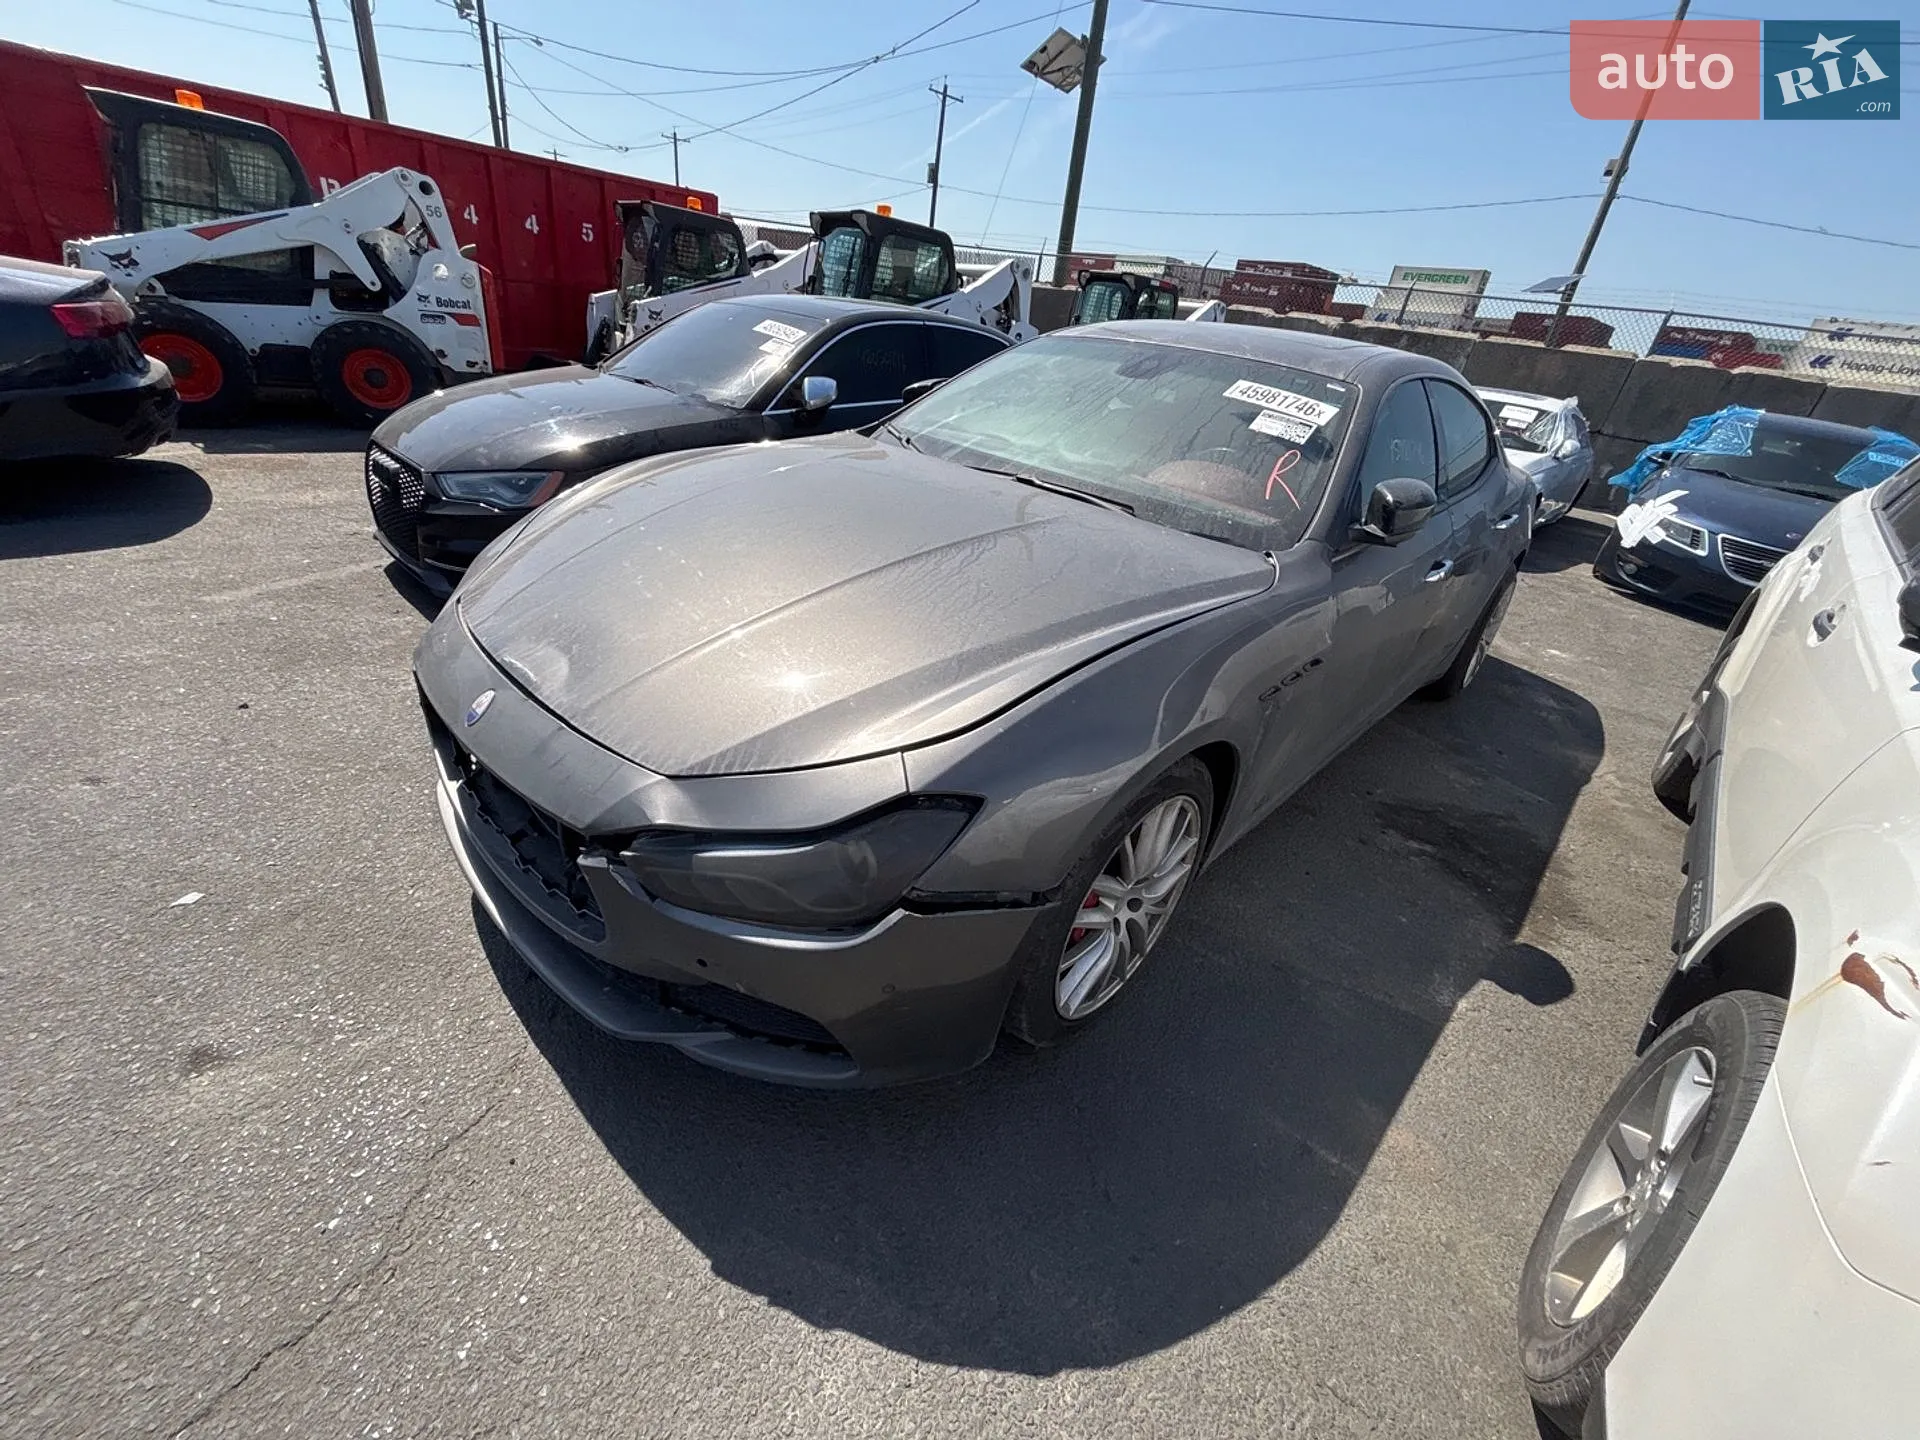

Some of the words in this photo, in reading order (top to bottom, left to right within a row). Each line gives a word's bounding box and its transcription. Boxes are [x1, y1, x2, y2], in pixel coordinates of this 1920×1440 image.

[425, 205, 443, 218] 56
[463, 204, 480, 225] 4
[524, 214, 540, 234] 4
[581, 223, 594, 243] 5
[1402, 271, 1470, 285] EVERGREEN
[435, 296, 472, 310] Bobcat
[1264, 449, 1301, 511] R
